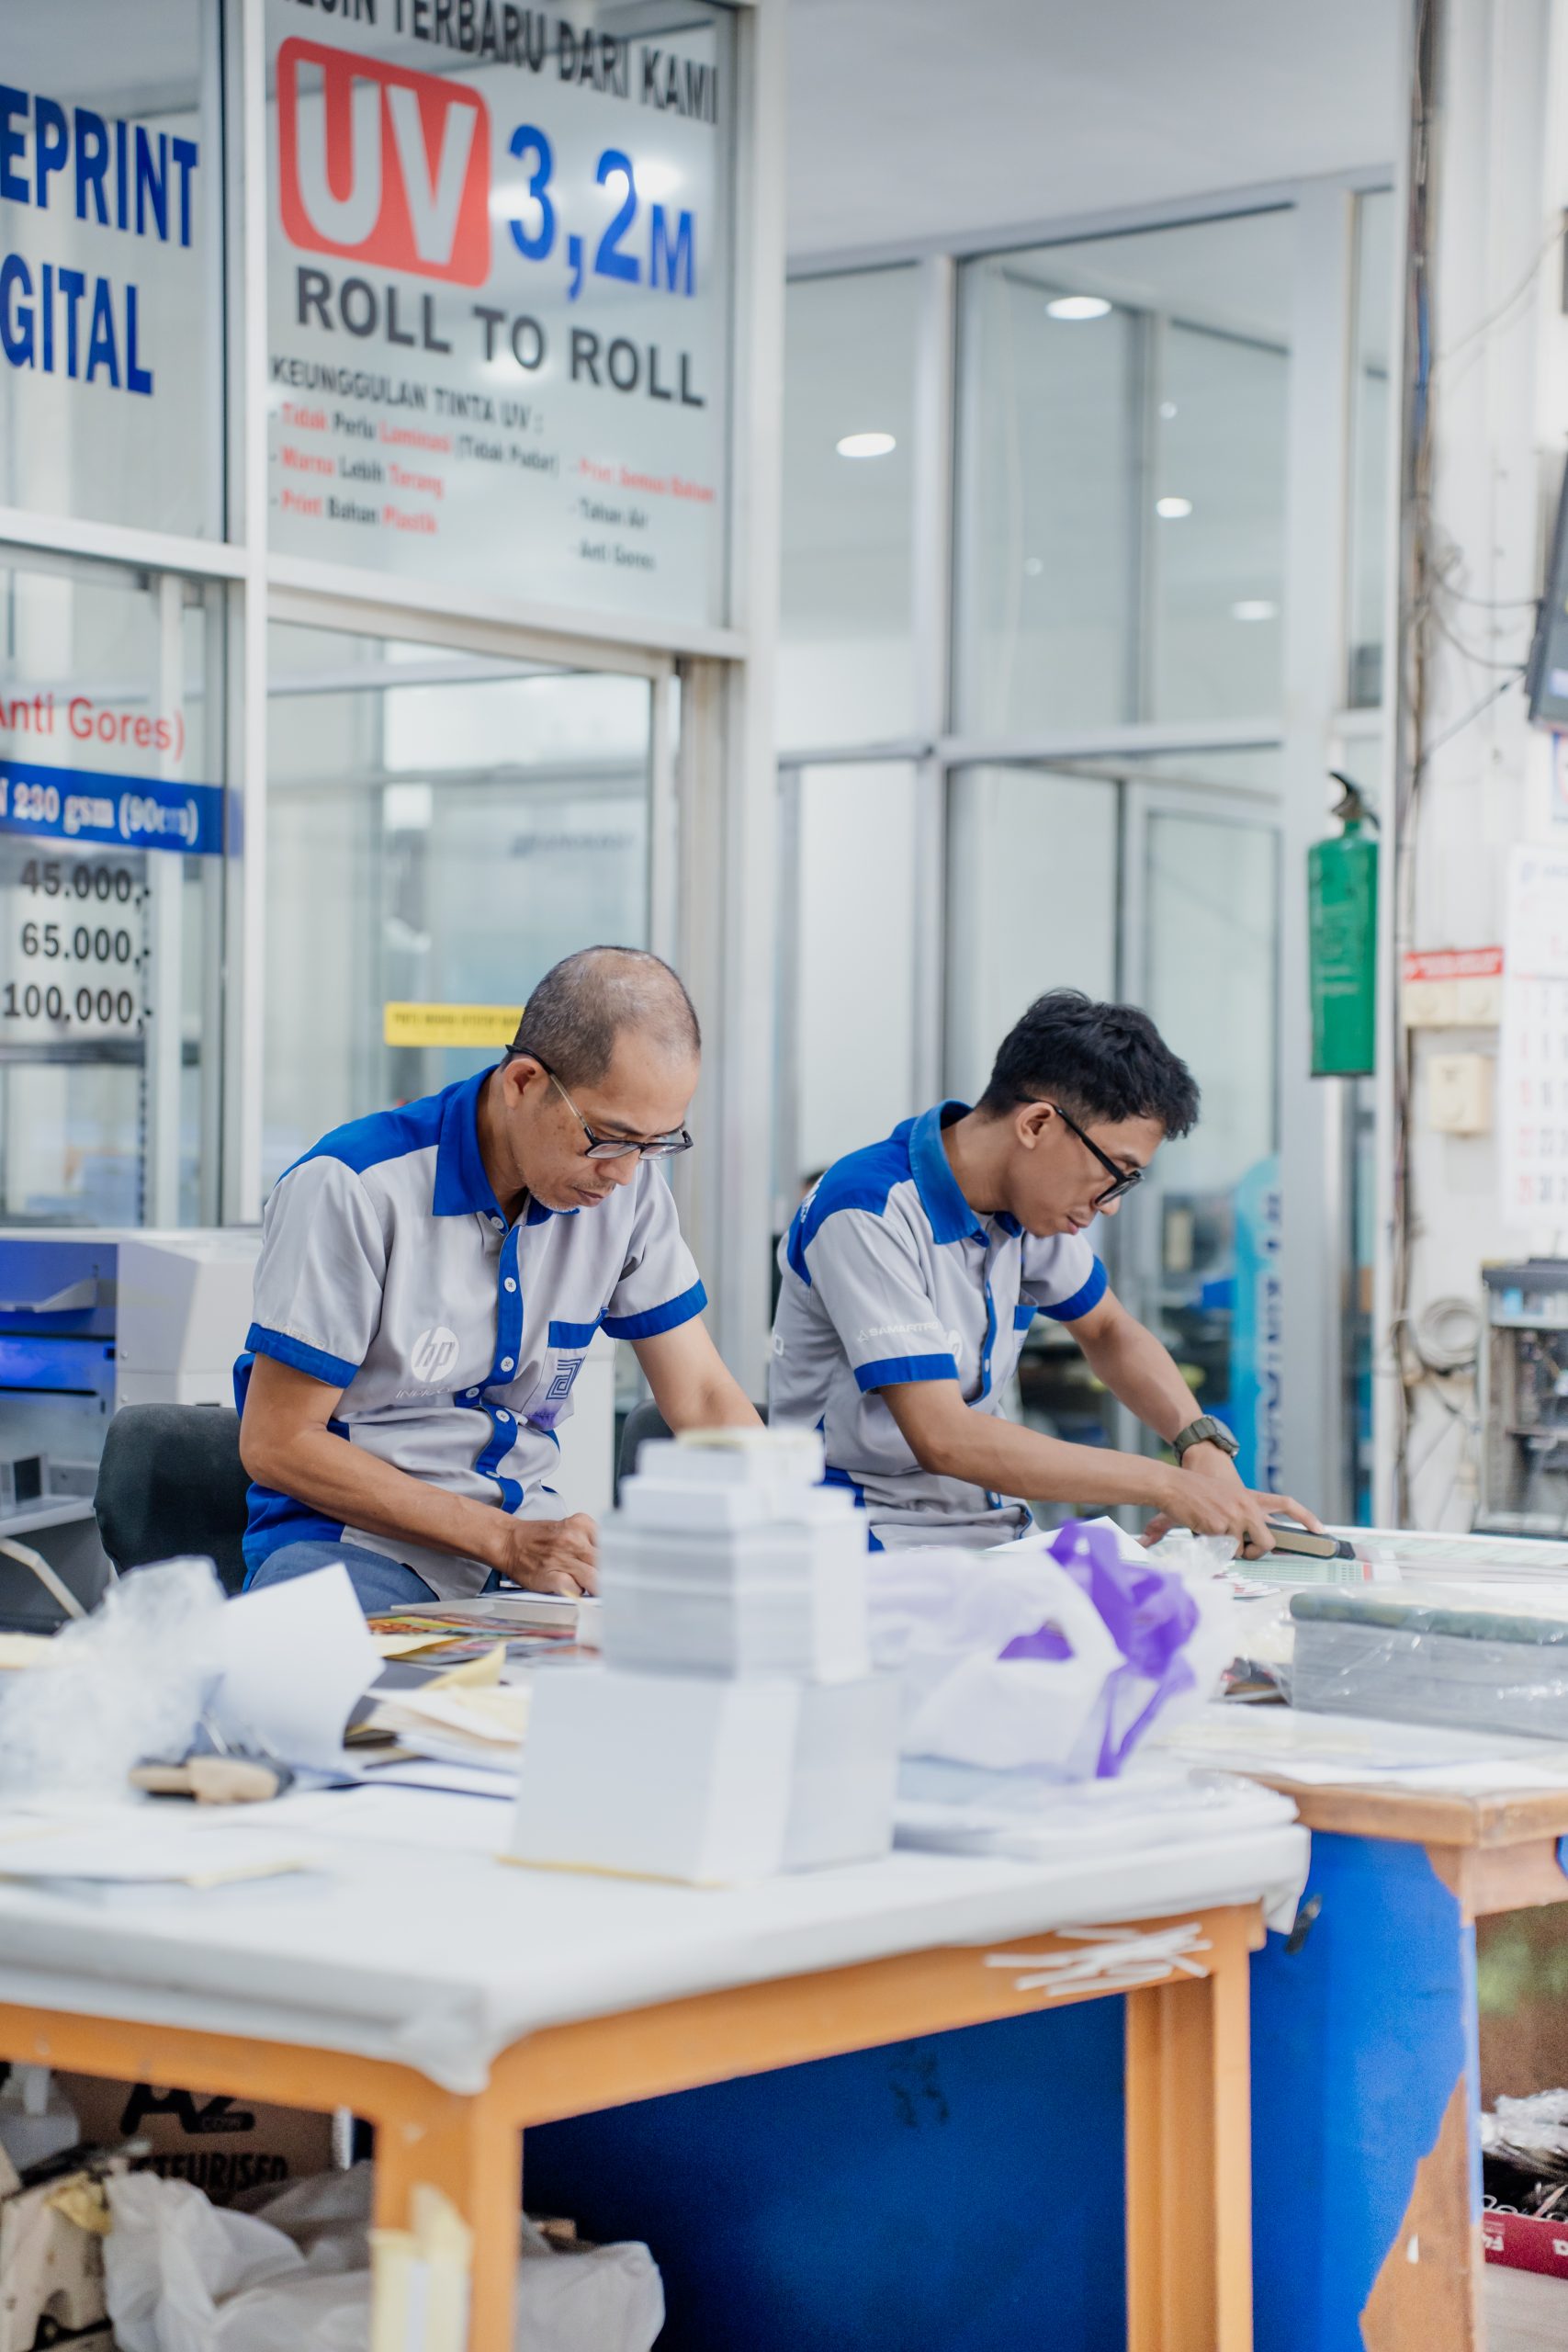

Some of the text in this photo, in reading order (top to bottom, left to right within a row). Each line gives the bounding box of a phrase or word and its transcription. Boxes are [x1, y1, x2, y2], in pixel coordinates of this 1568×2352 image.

[557, 19, 631, 98] DARI
[642, 46, 719, 125] KAMI
[0, 84, 199, 248] EPRINT
[295, 57, 479, 266] UV
[0, 253, 154, 397] GITAL
[296, 266, 706, 408] ROLL TO ROLL
[270, 356, 532, 430] KEUNGGULAN TINTA UV
[282, 401, 329, 432] Tidak
[281, 446, 336, 477] Warna
[340, 456, 384, 484] Lebih
[281, 489, 322, 518] Print
[69, 696, 185, 763] Gores)
[413, 1327, 456, 1383] hp
